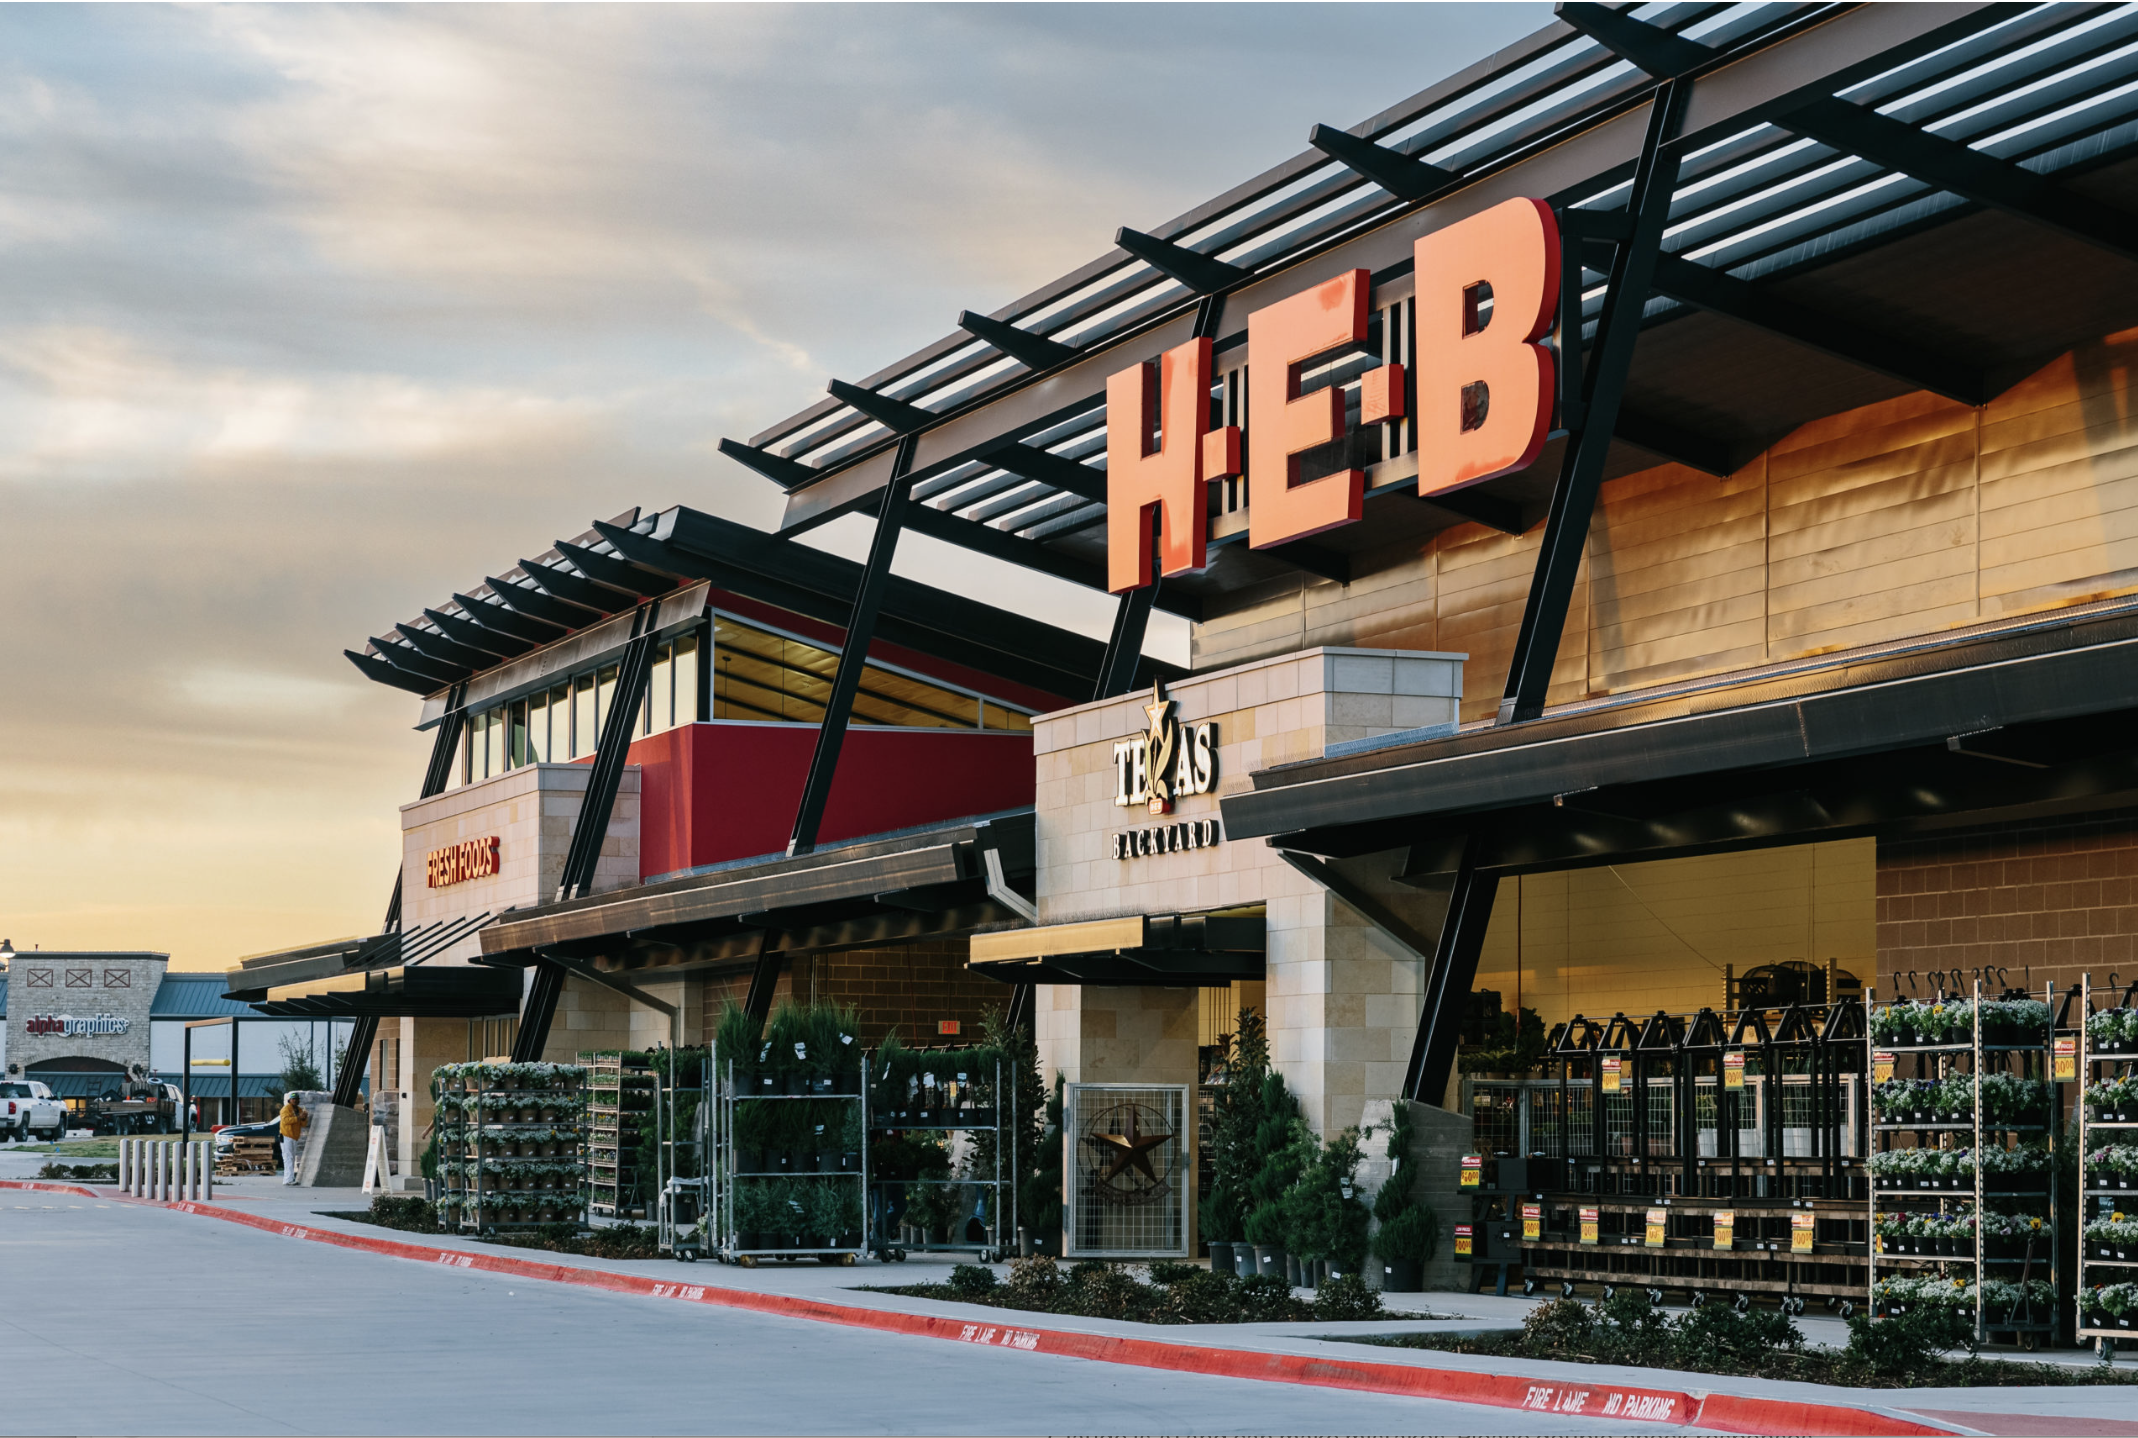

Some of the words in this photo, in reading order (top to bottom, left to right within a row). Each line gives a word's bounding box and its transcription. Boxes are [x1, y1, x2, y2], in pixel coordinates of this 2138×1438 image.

[1113, 721, 1215, 807] TEXAS
[1112, 819, 1216, 860] BACKYARD
[427, 844, 457, 888] FRESH
[459, 836, 496, 880] FOODS
[26, 1013, 126, 1038] alphagraphics
[942, 1021, 958, 1034] EXIT
[958, 1324, 978, 1341] FIRE
[974, 1327, 997, 1344] LANE
[999, 1329, 1014, 1346] NO
[1010, 1331, 1040, 1350] PARKING
[1522, 1386, 1554, 1409] FIRE
[1553, 1389, 1589, 1413] LANE
[1601, 1392, 1622, 1415] NO
[1621, 1394, 1675, 1420] PARKING
